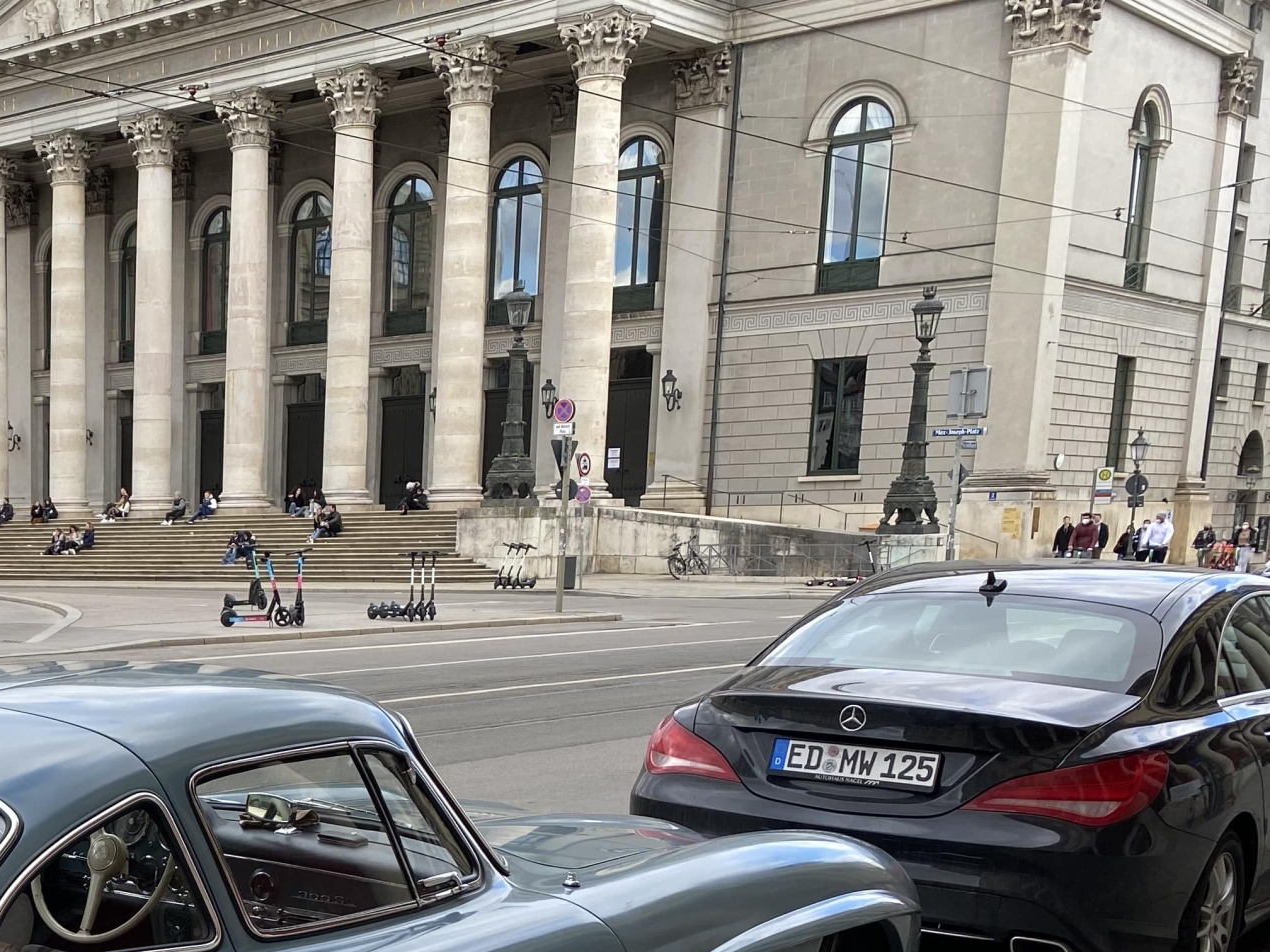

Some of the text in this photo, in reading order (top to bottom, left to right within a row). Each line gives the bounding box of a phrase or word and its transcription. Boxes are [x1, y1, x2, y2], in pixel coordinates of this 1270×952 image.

[787, 743, 823, 770] ED
[839, 749, 878, 776] MW
[880, 753, 937, 782] 125
[845, 777, 863, 785] NAGEL
